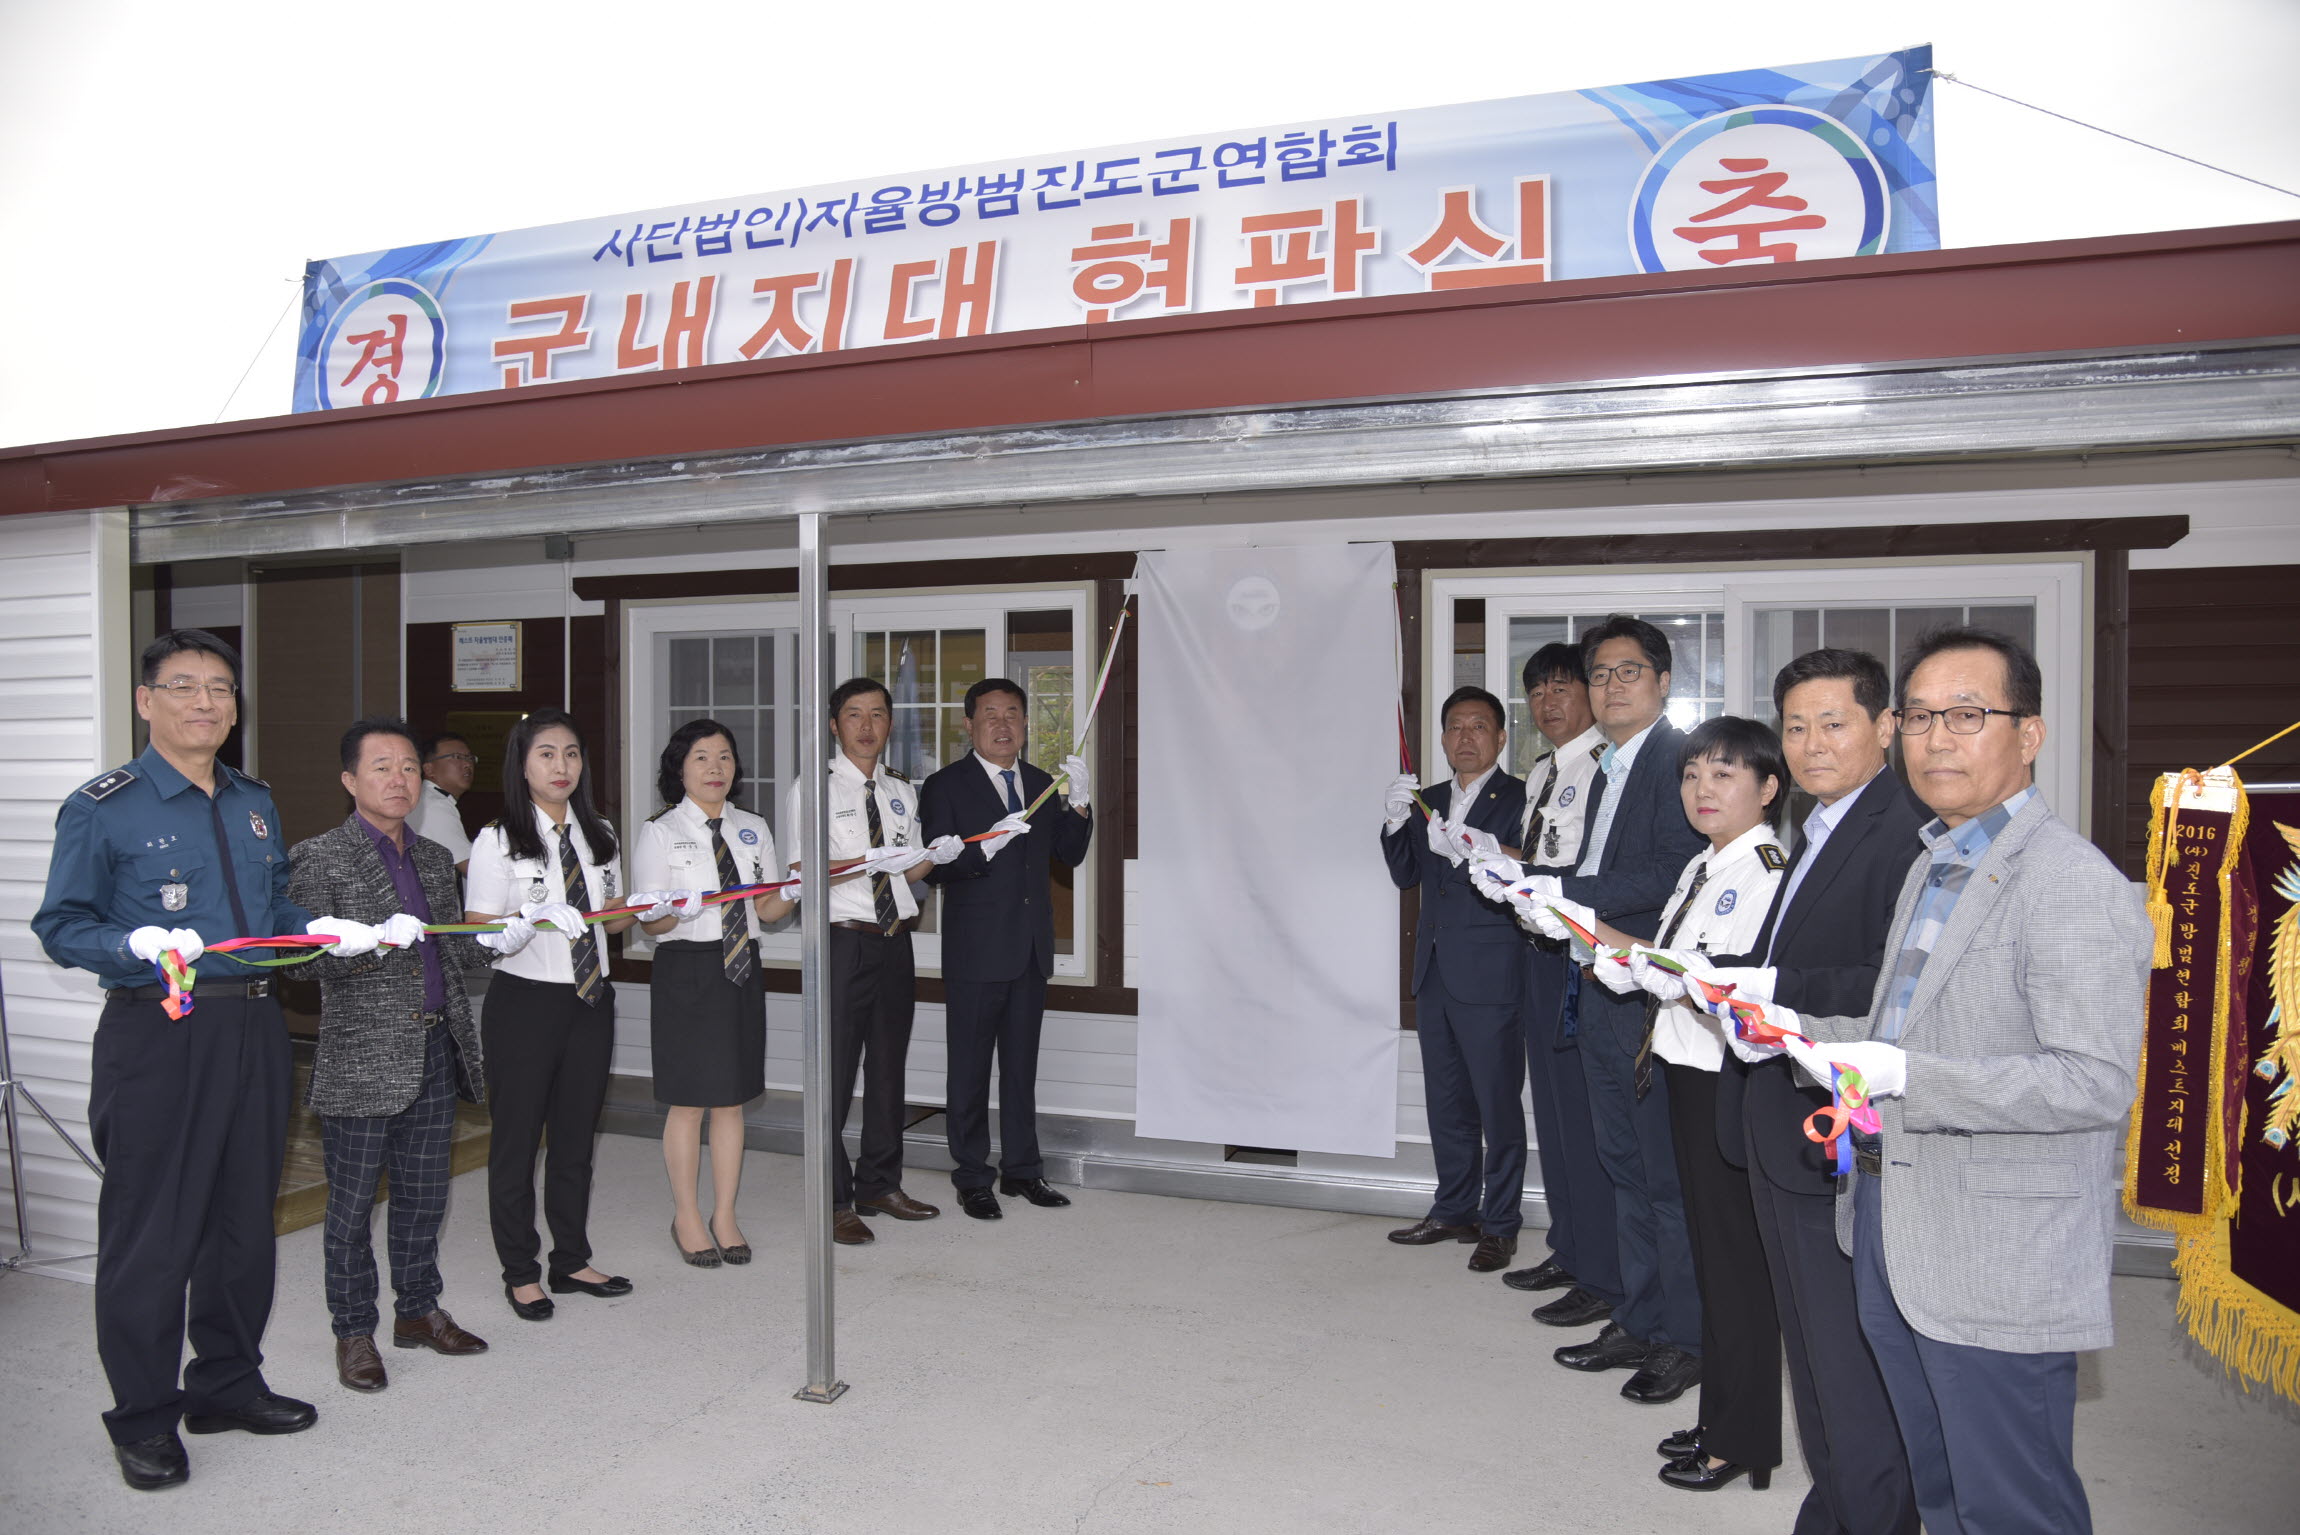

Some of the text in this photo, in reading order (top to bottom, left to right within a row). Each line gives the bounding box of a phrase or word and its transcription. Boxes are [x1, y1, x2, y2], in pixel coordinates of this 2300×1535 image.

[1673, 158, 1827, 265] 축
[493, 179, 1545, 390] 군내지대 현판식
[340, 314, 408, 406] 경
[2176, 824, 2217, 840] 2016
